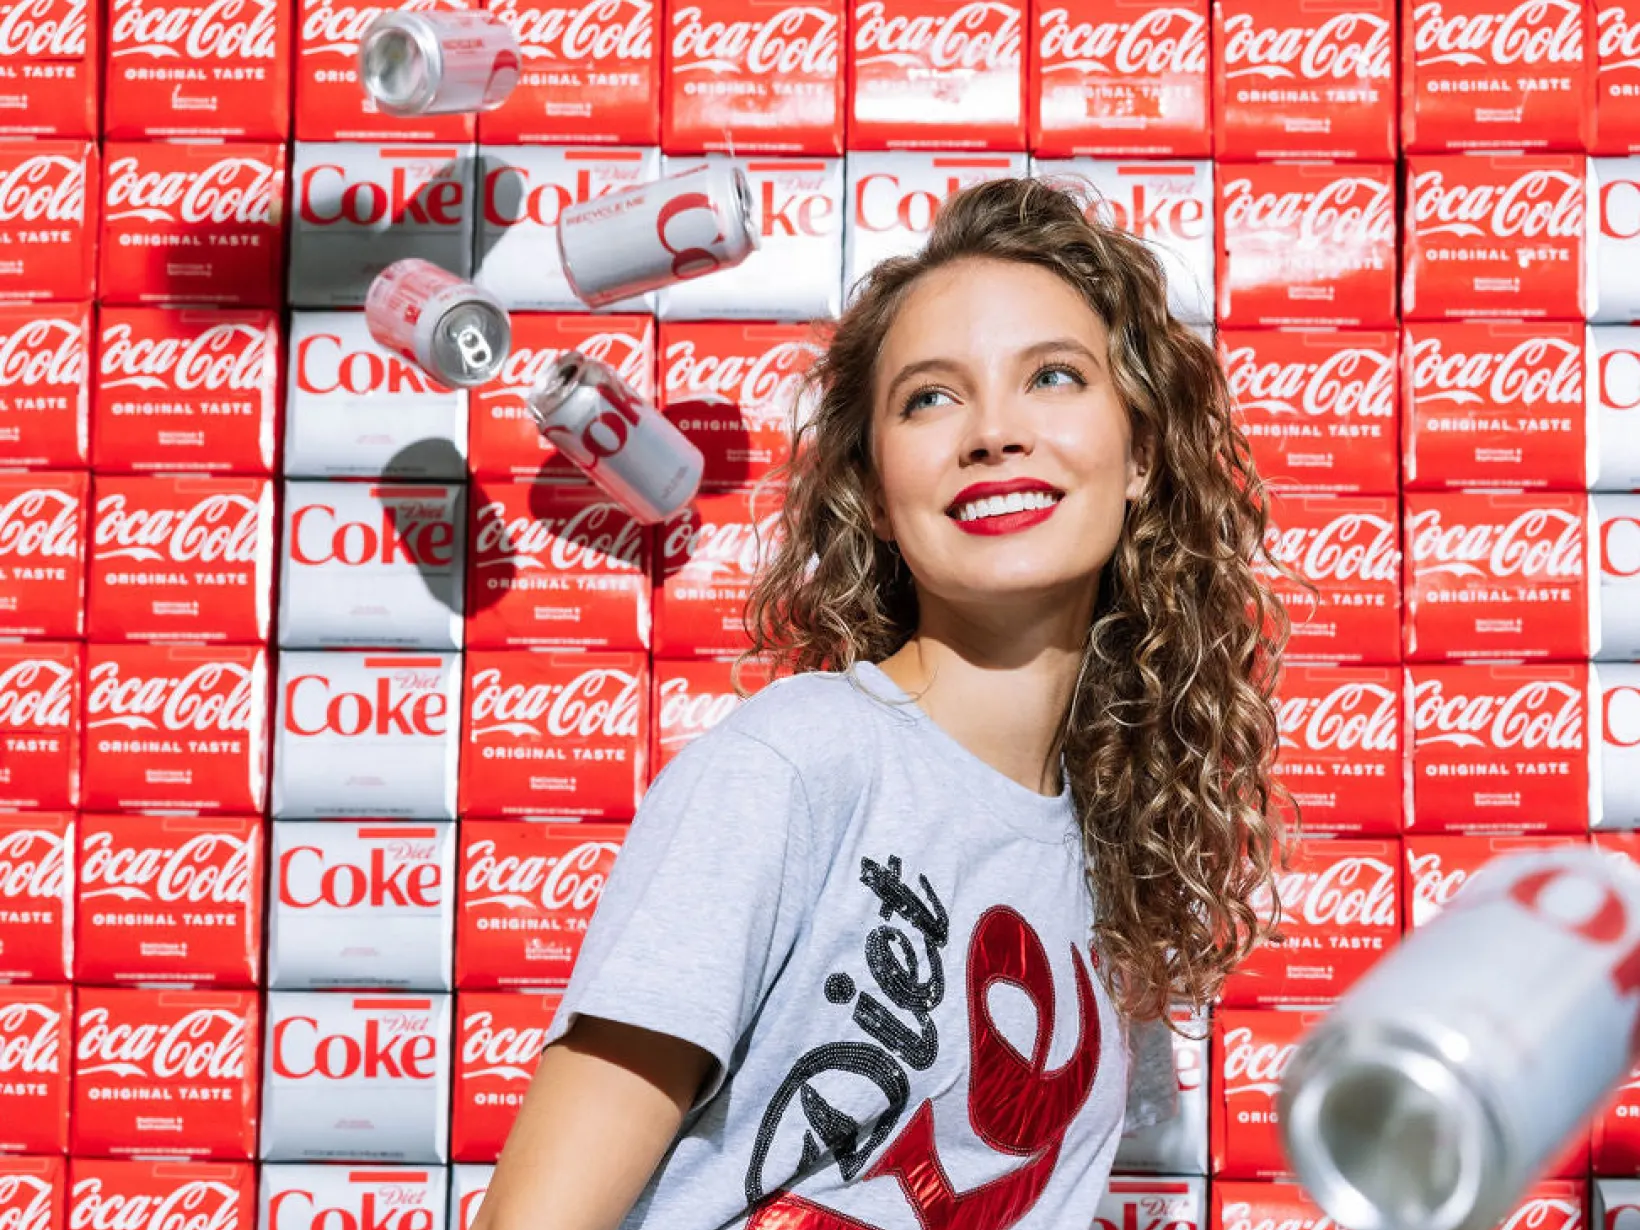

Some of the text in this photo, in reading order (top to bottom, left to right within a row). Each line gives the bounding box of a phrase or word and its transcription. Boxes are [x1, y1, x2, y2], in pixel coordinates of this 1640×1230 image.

[23, 67, 75, 79] TASTE
[125, 67, 265, 81] ORIGINAL TASTE
[515, 72, 639, 87] IGINAL TASTE
[685, 83, 824, 96] ORIGINAL TASTE
[1428, 79, 1571, 92] ORIGINAL TASTE
[1238, 89, 1379, 102] ORIGINAL TASTE
[301, 164, 463, 225] Coke
[761, 181, 834, 236] ke
[1090, 183, 1205, 240] oke
[20, 231, 71, 243] TASTE
[120, 233, 259, 246] ORIGINAL TASTE
[657, 192, 725, 279] Co
[1427, 249, 1570, 261] ORIGINAL TASTE
[297, 334, 453, 394] Cok
[15, 398, 67, 410] TASTE
[113, 402, 252, 416] ORIGINAL TASTE
[1427, 417, 1571, 431] ORIGINAL TASTE
[1239, 425, 1380, 437] ORIGINAL TASTE
[291, 504, 453, 565] Coke
[1254, 514, 1396, 581] ca-Cola
[14, 569, 65, 581] TASTE
[105, 572, 247, 585] ORIGINAL TASTE
[487, 578, 628, 590] ORIGINAL TASTE
[675, 587, 750, 600] ORIGINA
[1277, 593, 1385, 606] GINAL TASTE
[1427, 589, 1571, 602] ORIGINAL TASTE
[396, 671, 441, 690] Diet
[285, 675, 447, 736] Coke
[1277, 683, 1396, 751] a-Cola
[7, 740, 59, 752] TASTE
[98, 740, 240, 753] ORIGINAL TASTE
[483, 747, 625, 760] ORIGINAL TASTE
[1272, 764, 1385, 776] GINAL TASTE
[1425, 764, 1569, 776] ORIGINAL TASTE
[389, 841, 436, 861] Diet
[279, 845, 441, 908] Coke
[466, 841, 616, 910] oca-Co
[1252, 858, 1394, 925] ca-Cola
[0, 911, 52, 924] TASTE
[92, 914, 236, 926] ORIGINAL TASTE
[477, 918, 559, 930] ORIGINAL
[1328, 937, 1381, 949] TASTE
[384, 1014, 429, 1035] Diet
[745, 853, 949, 1205] Diet
[273, 1017, 436, 1079] Coke
[89, 1088, 231, 1100] ORIGINAL TASTE
[475, 1093, 523, 1105] ORIGI
[380, 1185, 427, 1206] Diet
[1141, 1197, 1189, 1217] Di
